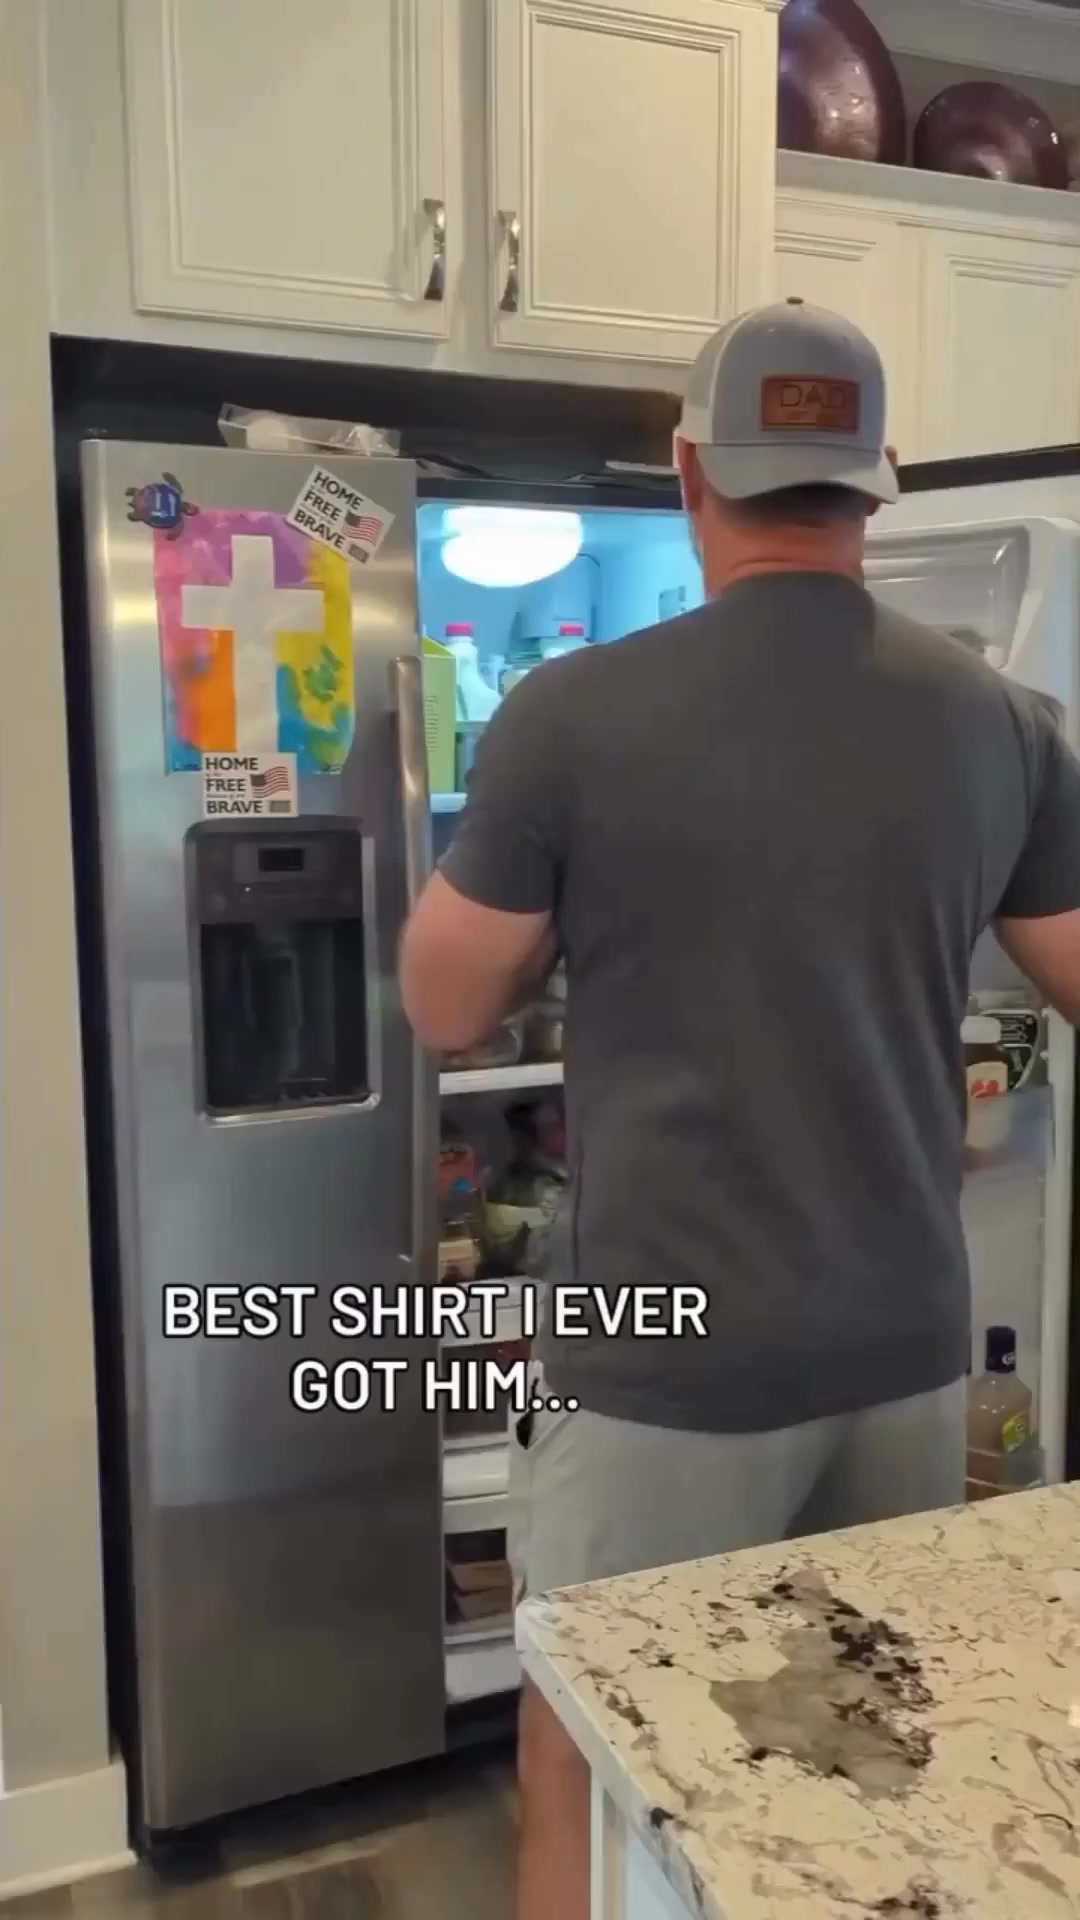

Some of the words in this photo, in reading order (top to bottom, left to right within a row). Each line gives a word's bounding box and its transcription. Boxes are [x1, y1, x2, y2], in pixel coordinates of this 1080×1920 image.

[780, 383, 848, 408] DAD
[313, 471, 364, 511] HOME
[303, 490, 342, 521] FREE
[293, 509, 345, 549] BRAVE
[205, 757, 259, 771] HOME
[206, 778, 247, 793] FREE
[206, 800, 263, 814] BRAVE
